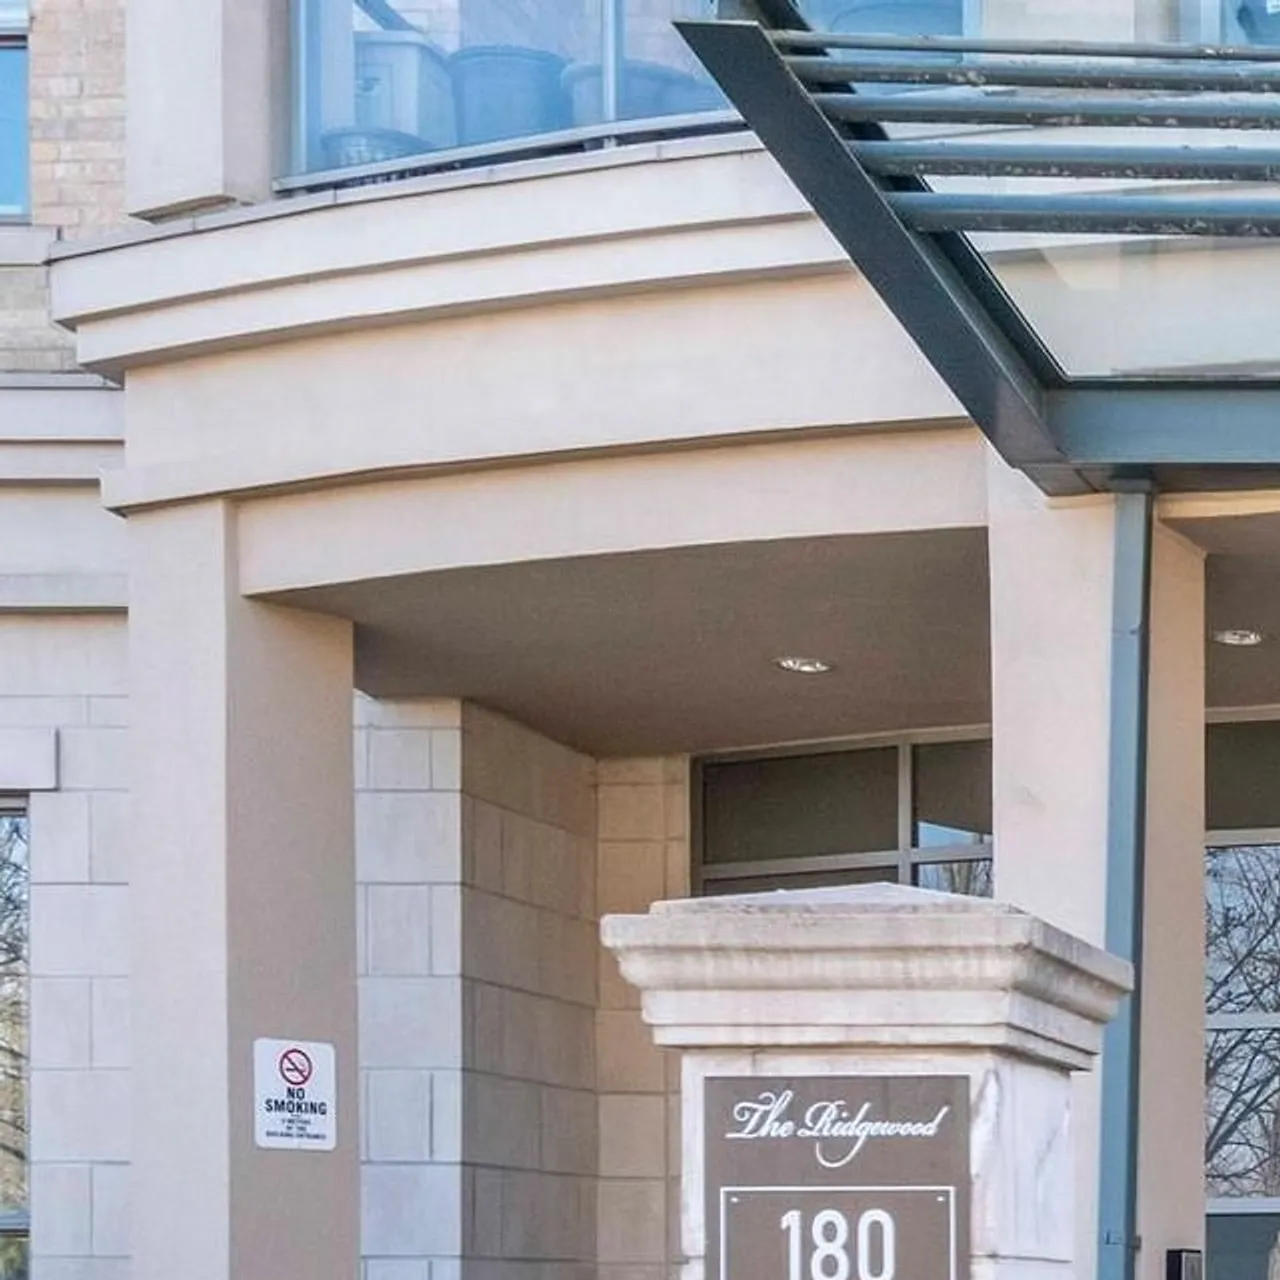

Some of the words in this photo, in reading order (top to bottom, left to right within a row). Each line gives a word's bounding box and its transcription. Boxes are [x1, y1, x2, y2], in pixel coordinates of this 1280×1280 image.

[286, 1087, 305, 1100] NO
[265, 1098, 327, 1115] SMOKING
[725, 1090, 794, 1138] The
[798, 1100, 950, 1168] Ridgewood
